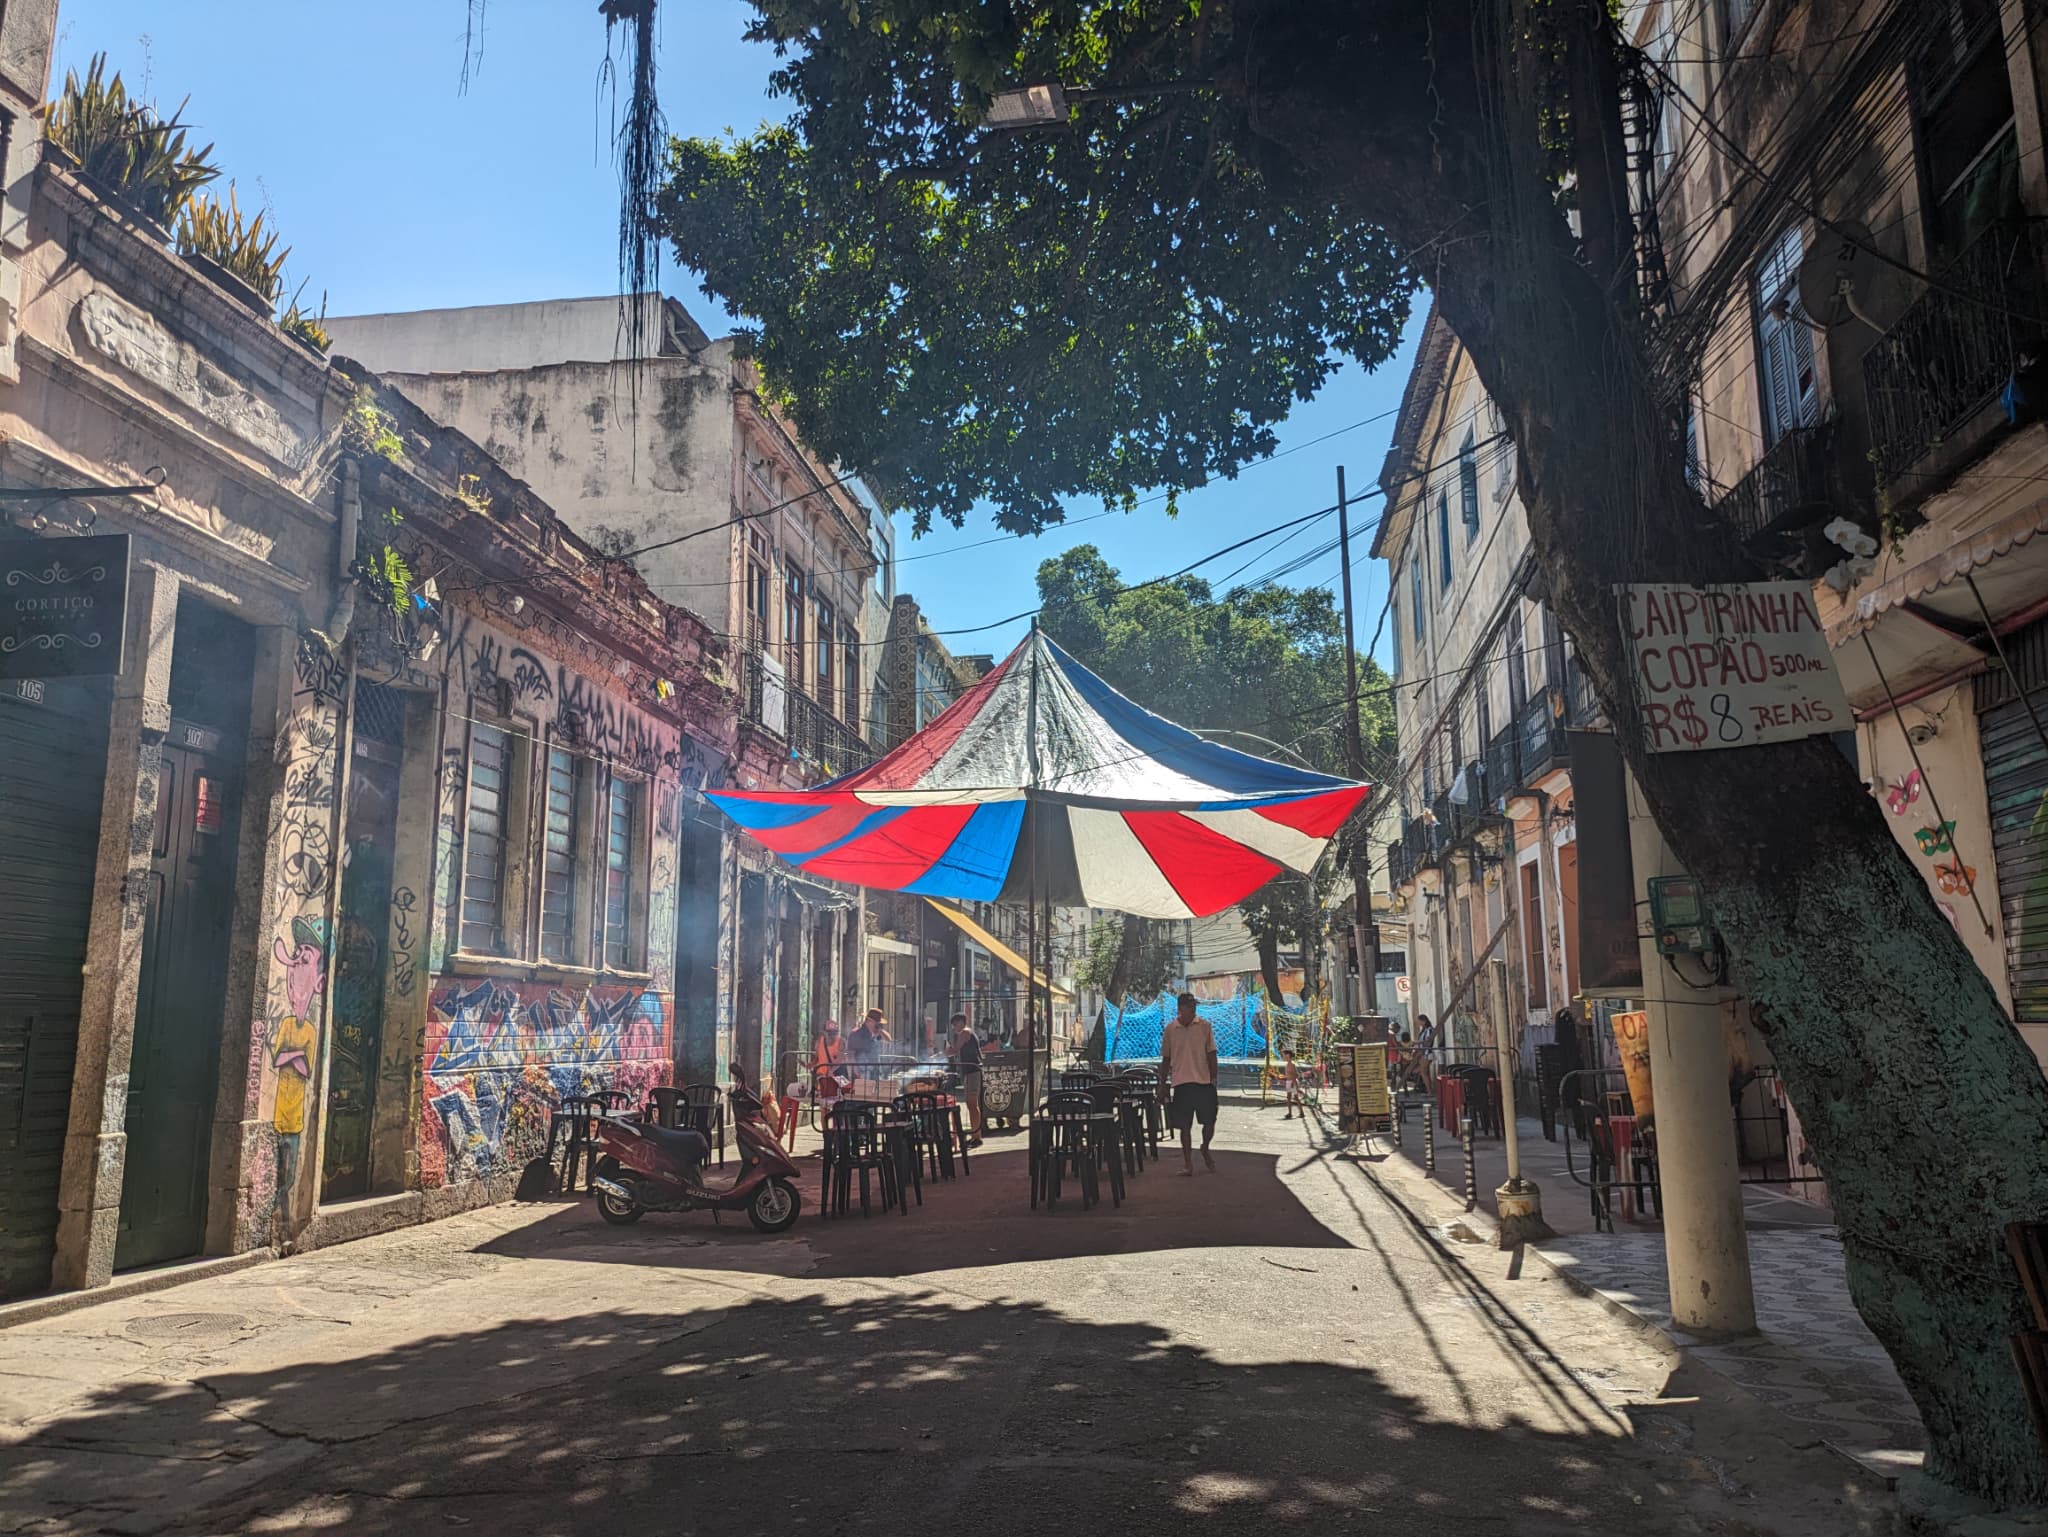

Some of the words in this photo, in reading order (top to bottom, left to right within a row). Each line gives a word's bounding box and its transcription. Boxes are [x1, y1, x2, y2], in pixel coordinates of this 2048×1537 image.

[1622, 585, 1825, 640] CAIPIRINHA
[21, 680, 42, 700] 105
[1640, 636, 1768, 692] COPÃO
[1642, 694, 1709, 750] R$
[1710, 693, 1743, 742] 8
[1751, 696, 1834, 728] REAIS
